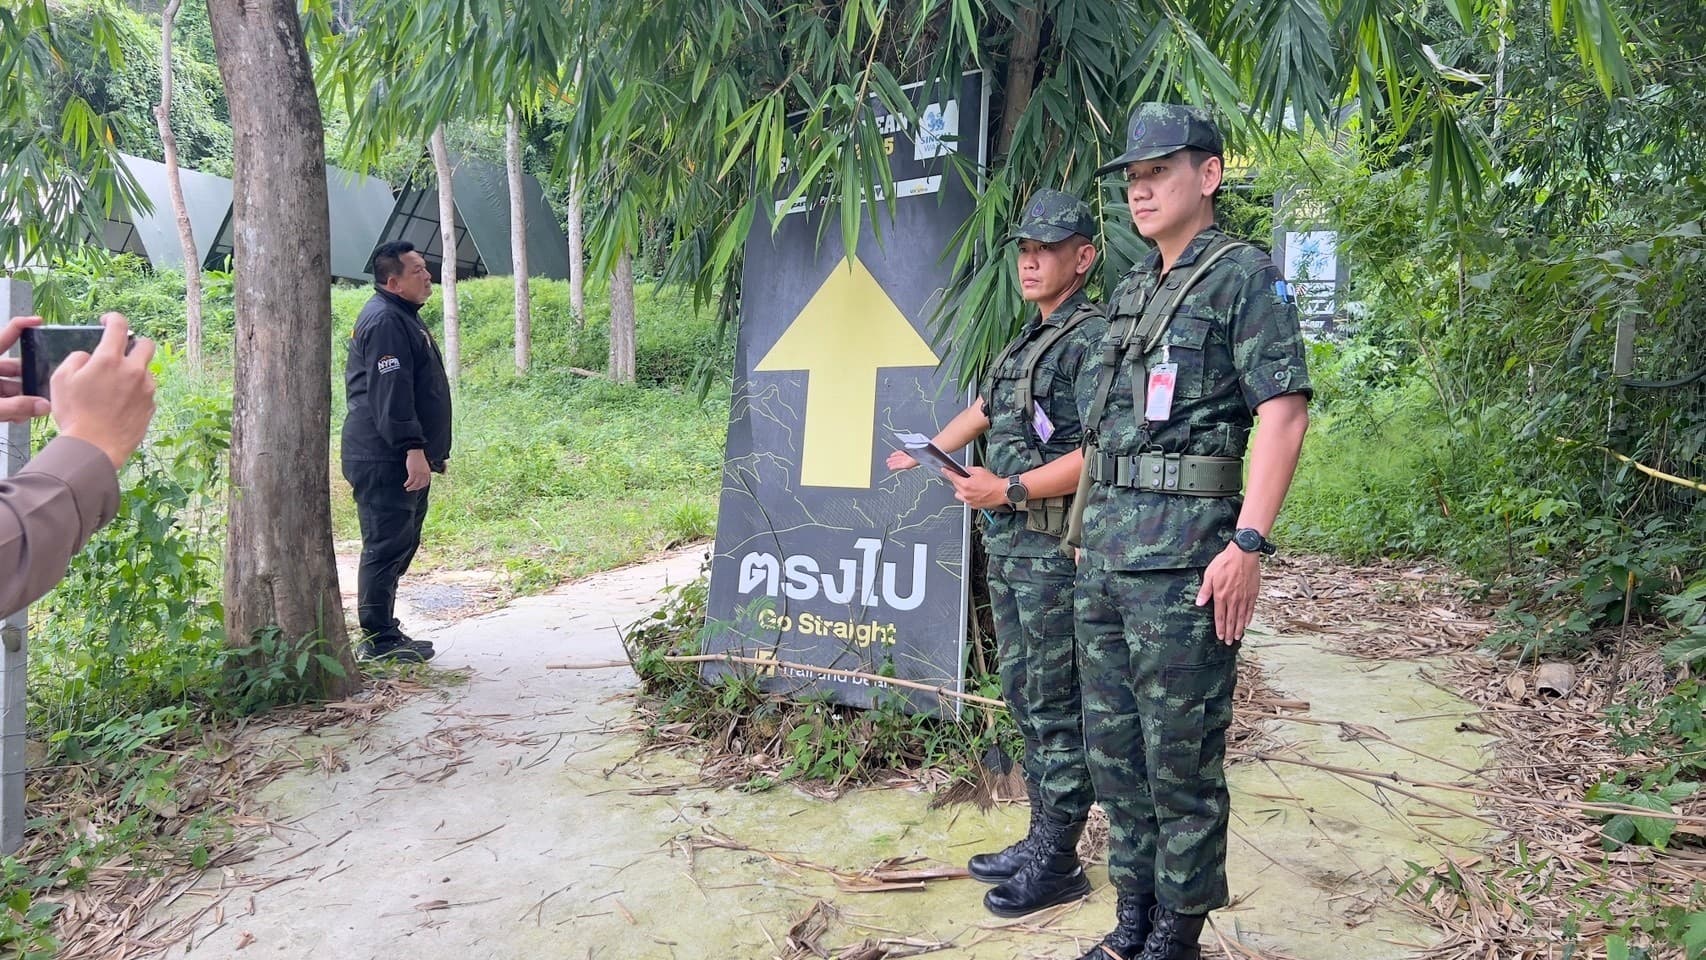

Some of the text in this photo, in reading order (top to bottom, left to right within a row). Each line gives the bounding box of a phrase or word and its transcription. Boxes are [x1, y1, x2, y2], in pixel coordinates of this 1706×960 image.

[738, 537, 928, 611] ตรงไป
[758, 608, 897, 648] Go Straight
